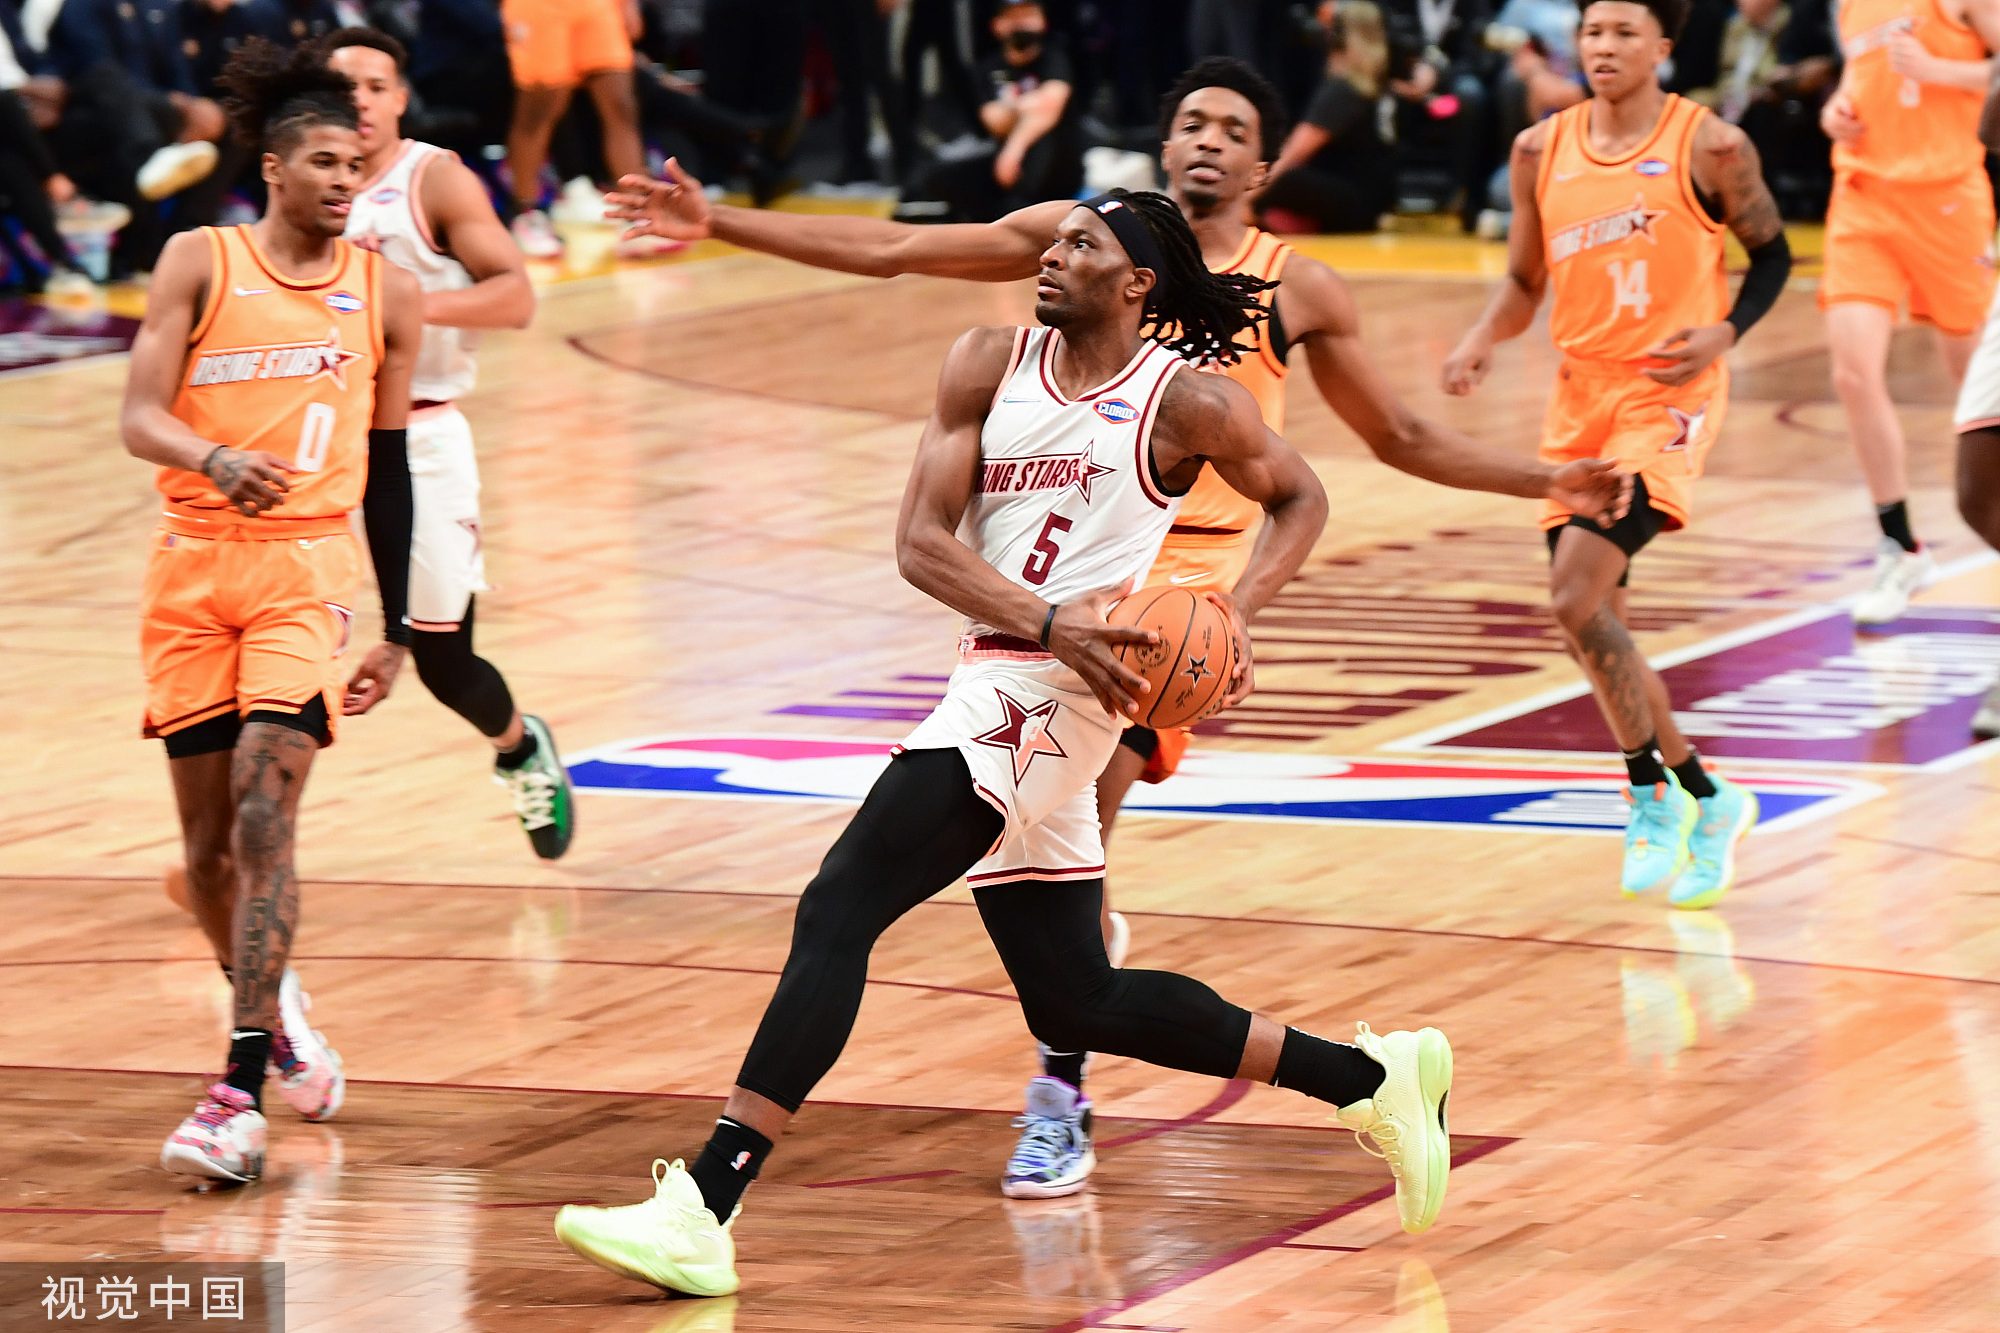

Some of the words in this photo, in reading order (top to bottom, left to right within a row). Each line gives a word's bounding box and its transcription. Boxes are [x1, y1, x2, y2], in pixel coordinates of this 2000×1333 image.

[1607, 259, 1652, 319] 14
[188, 351, 264, 386] RISING
[257, 345, 328, 379] STARS
[1098, 402, 1136, 420] CLOROX
[294, 402, 336, 473] 0
[1014, 458, 1080, 492] STARS
[1022, 511, 1073, 585] 5
